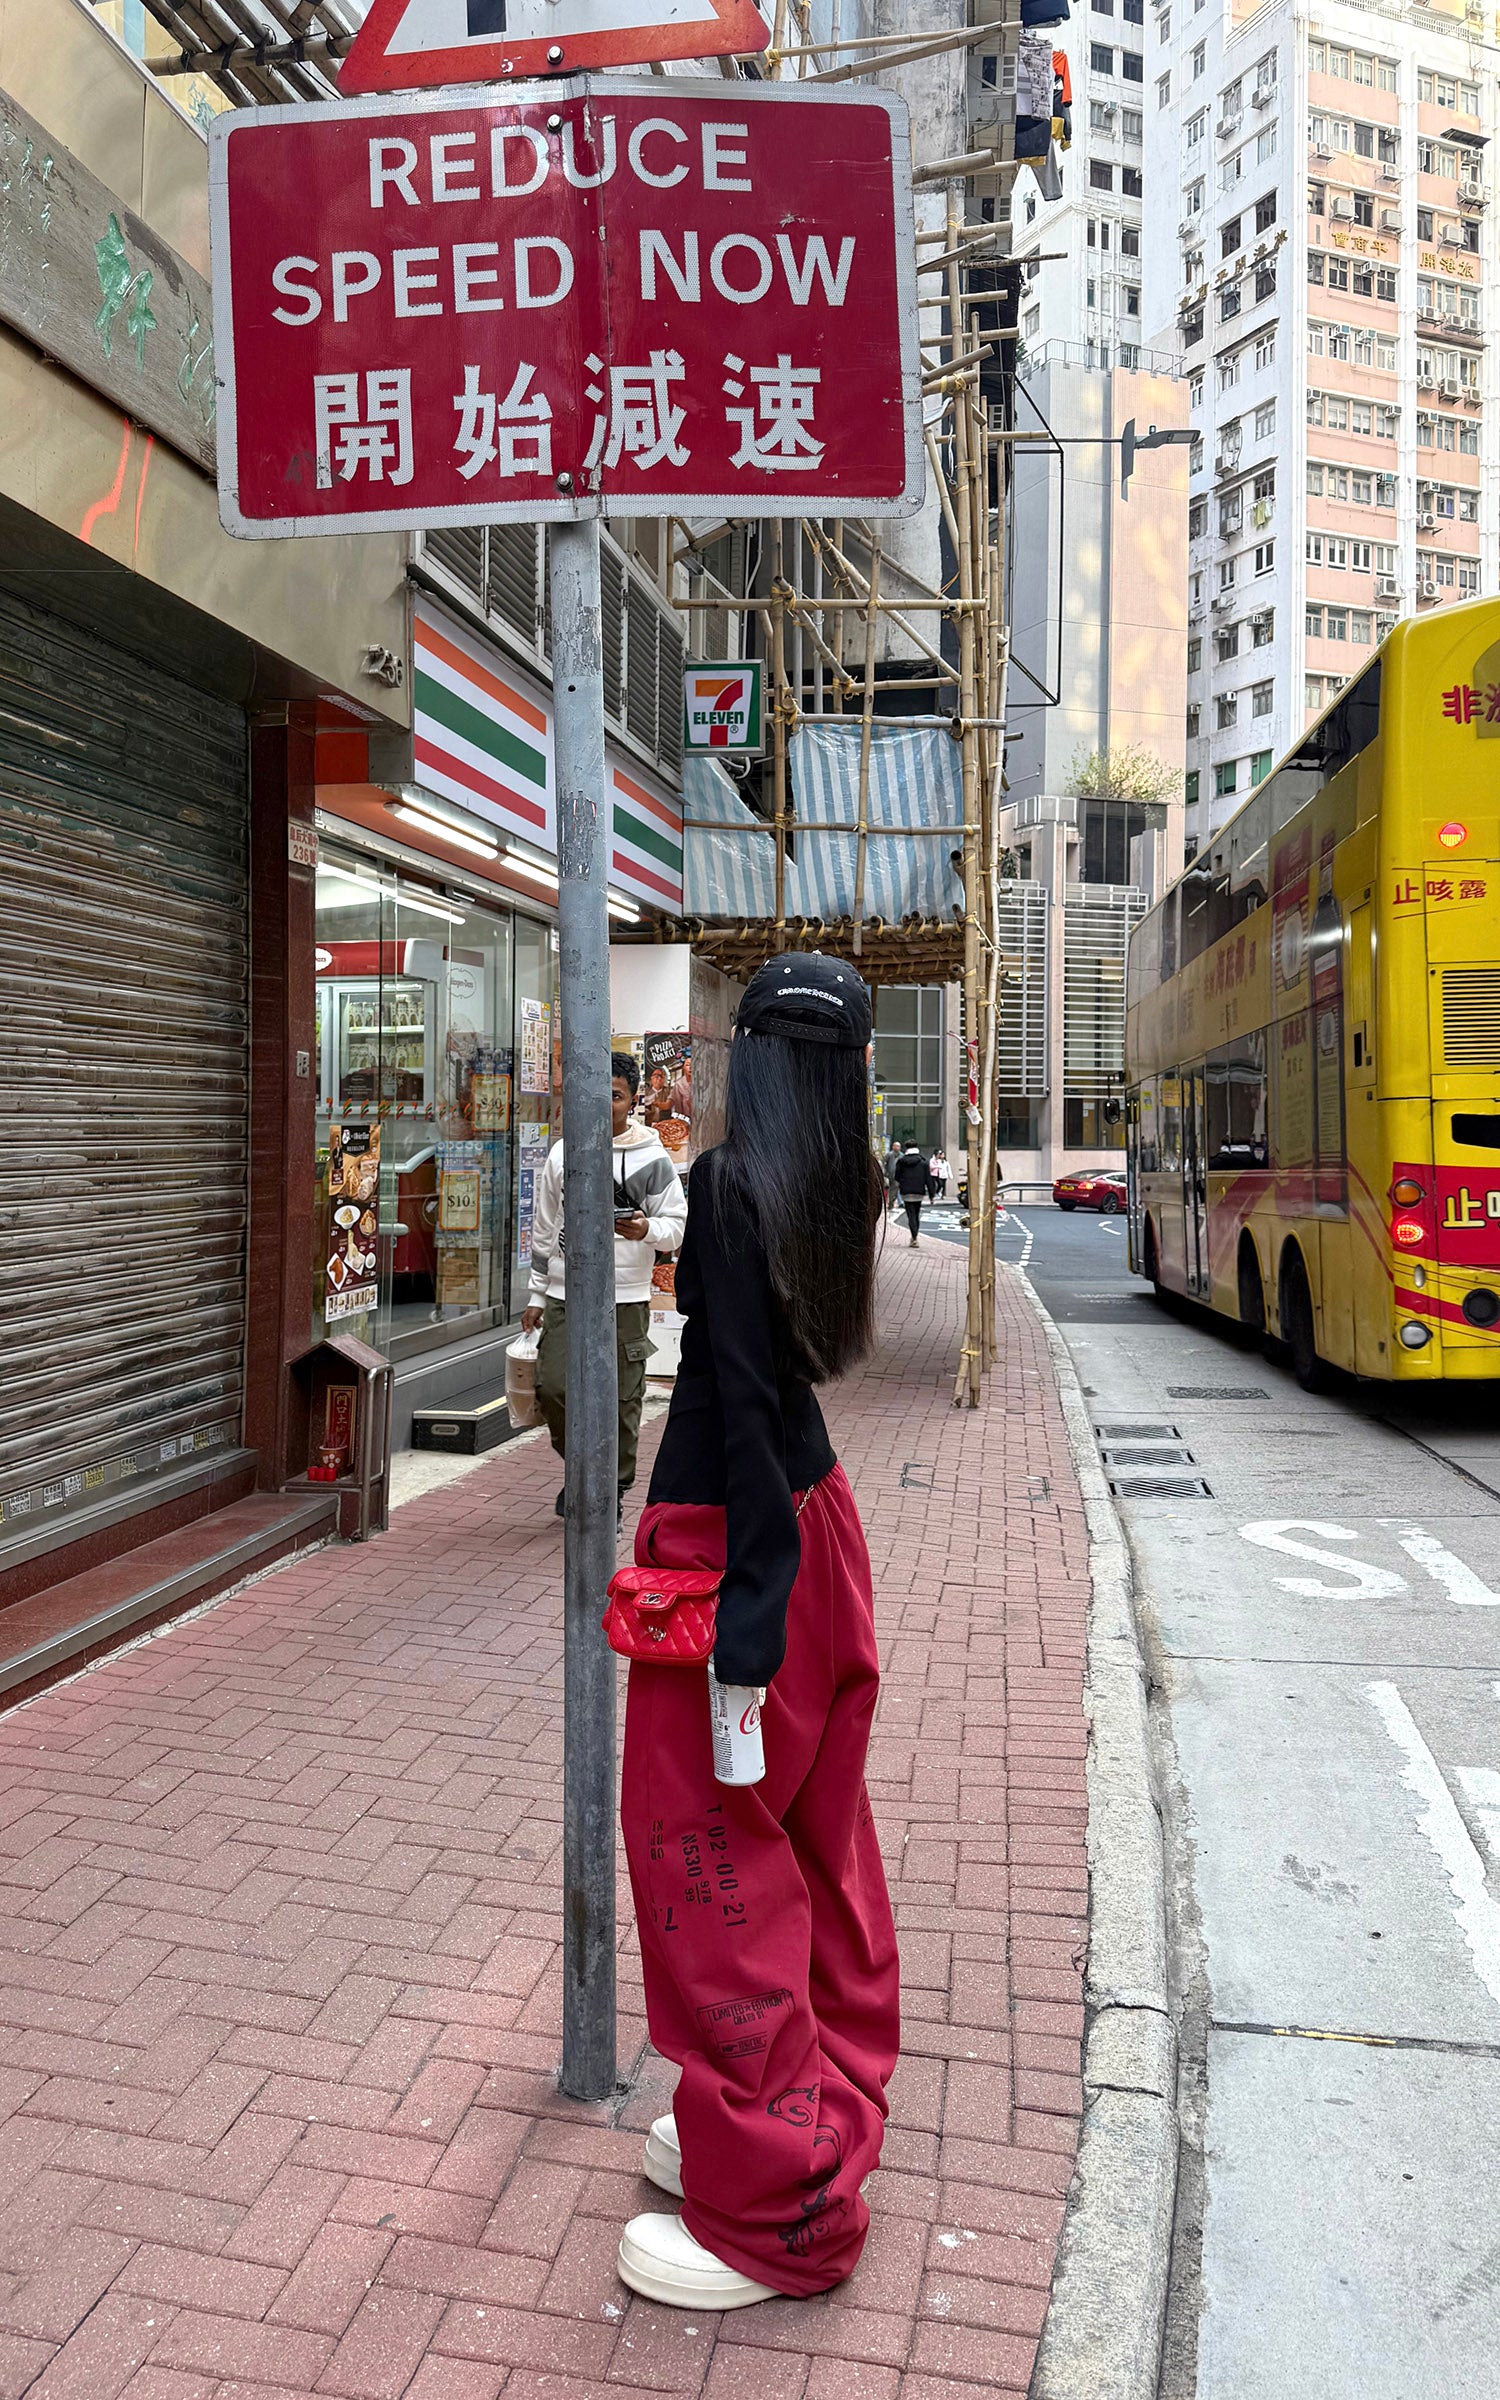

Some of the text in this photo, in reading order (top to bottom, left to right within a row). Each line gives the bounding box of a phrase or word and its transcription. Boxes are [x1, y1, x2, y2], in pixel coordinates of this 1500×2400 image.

[368, 117, 752, 208] REDUCE
[272, 230, 857, 325] SPEED NOW
[313, 349, 826, 489] 開始減速
[361, 644, 403, 688] 236
[1392, 878, 1487, 905] 止咳露
[711, 1994, 783, 2021] LIMITED EDITION
